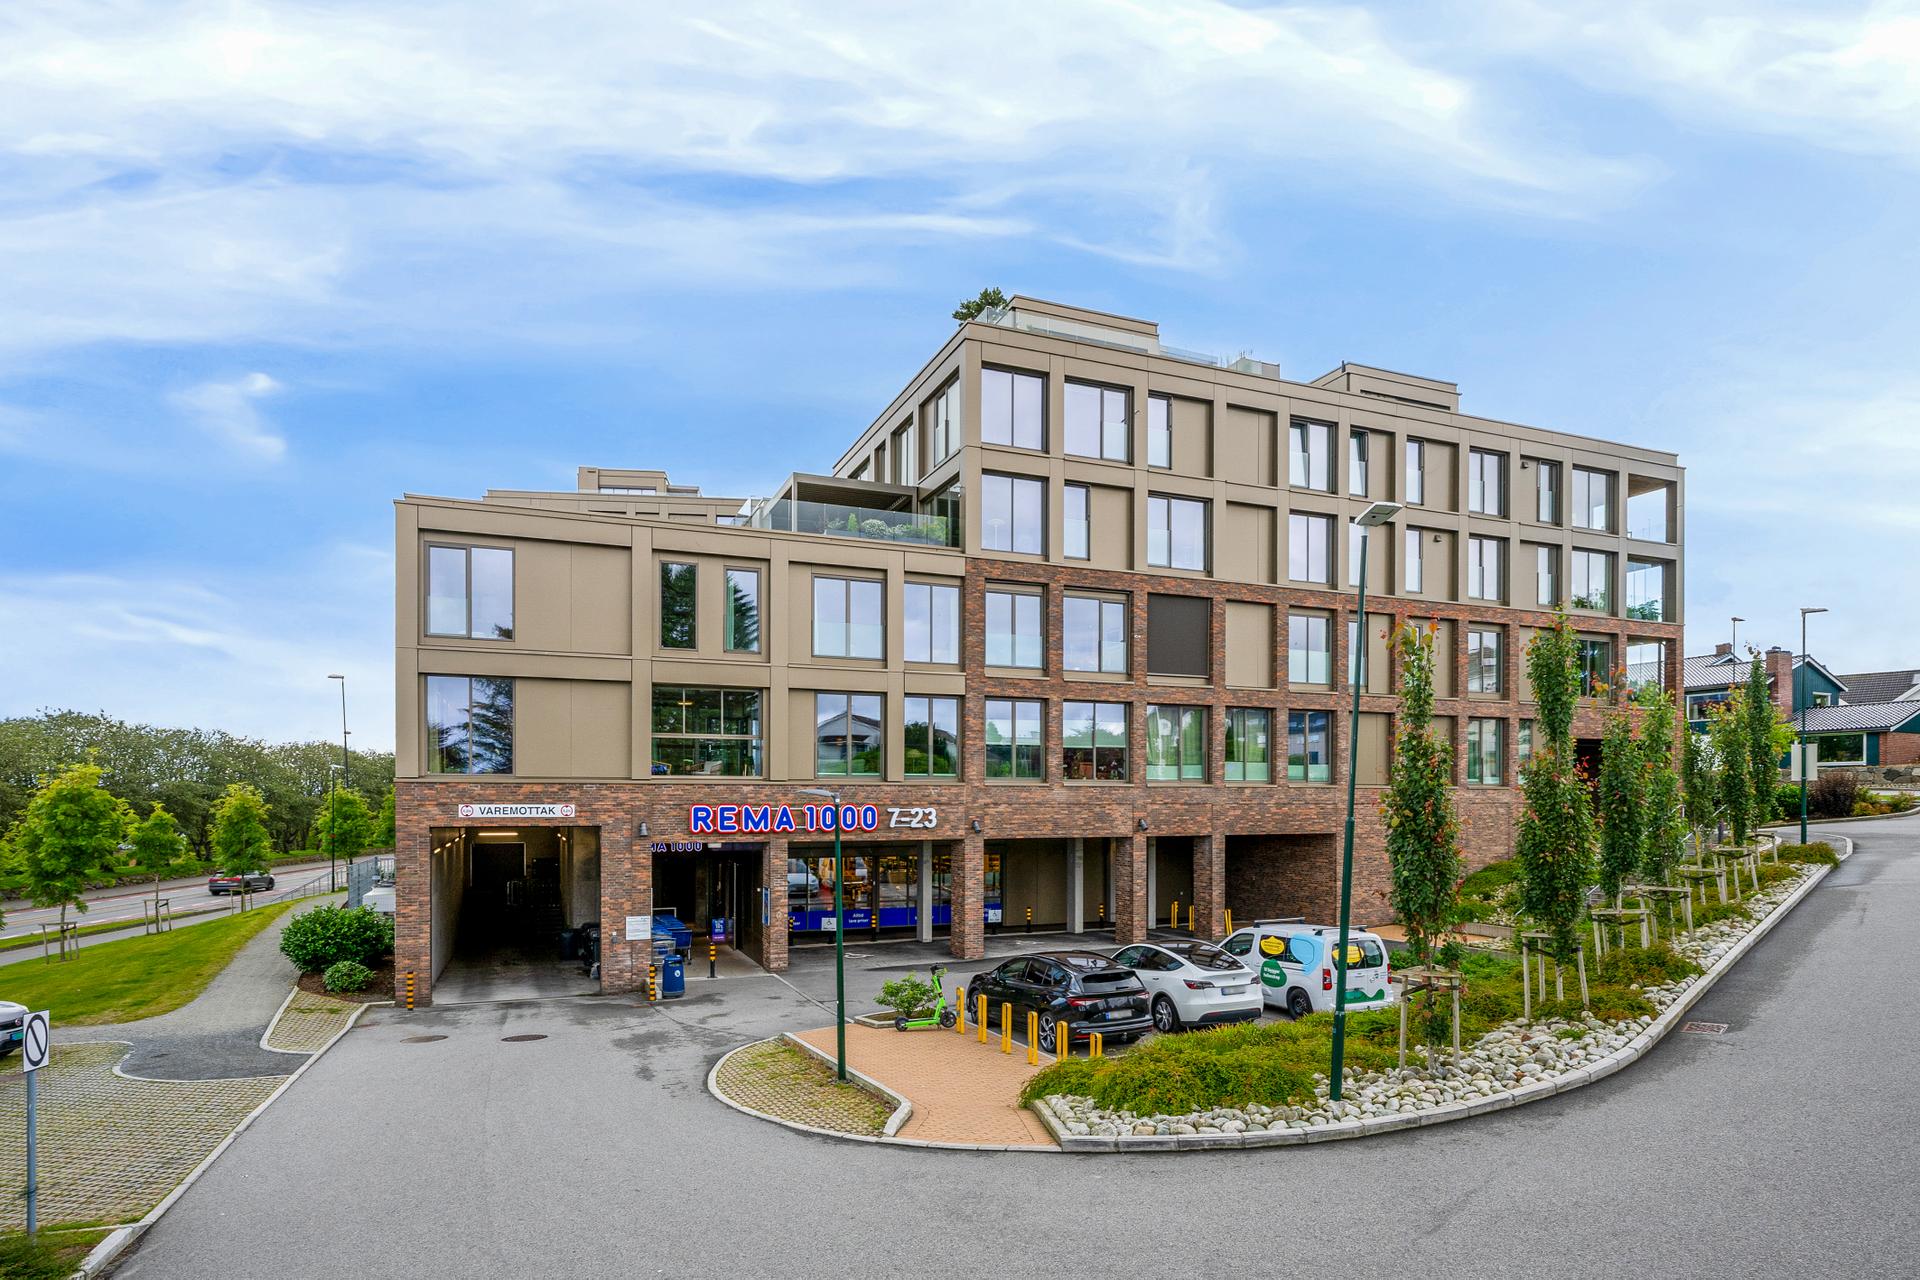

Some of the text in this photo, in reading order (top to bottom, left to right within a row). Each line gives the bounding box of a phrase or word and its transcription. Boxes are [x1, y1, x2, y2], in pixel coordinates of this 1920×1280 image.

[479, 806, 556, 816] VAREMOTTAK
[690, 803, 879, 834] REMA 1000
[887, 807, 938, 829] 7-23
[670, 841, 703, 853] 1000
